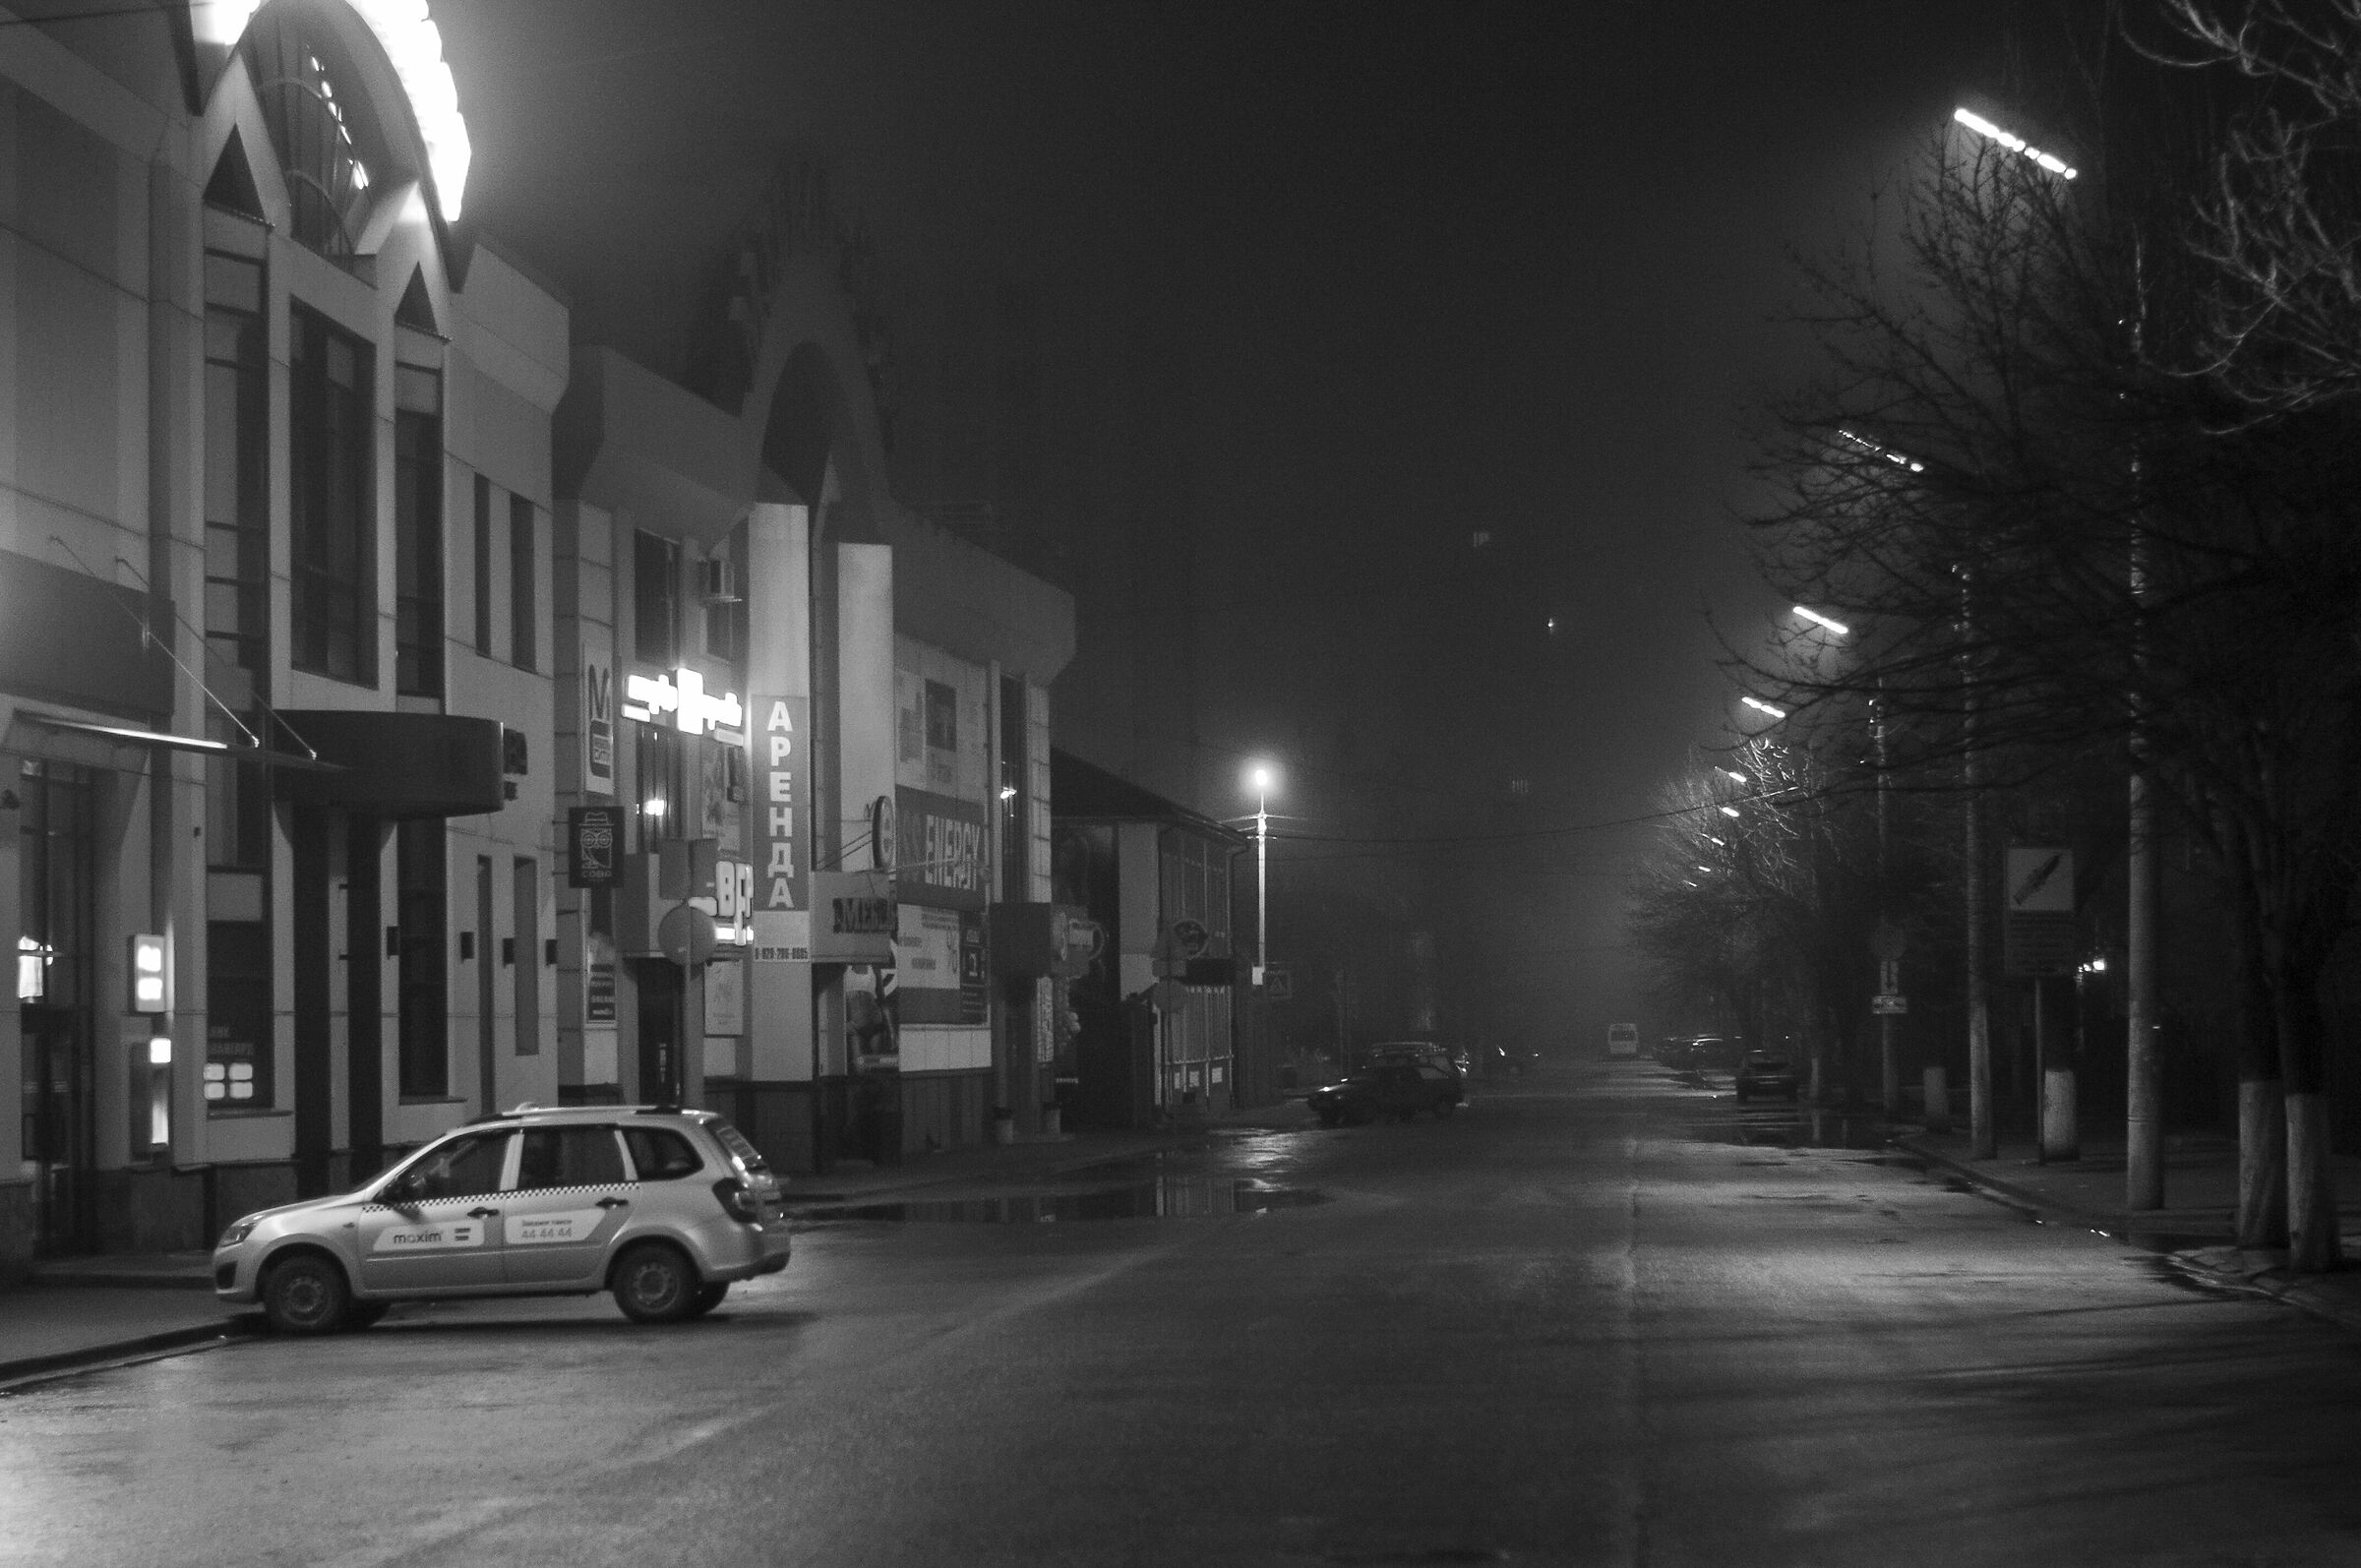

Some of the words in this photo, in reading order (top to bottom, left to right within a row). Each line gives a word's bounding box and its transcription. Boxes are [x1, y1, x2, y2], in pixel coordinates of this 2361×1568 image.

[767, 700, 794, 908] АРЕНДА
[925, 814, 980, 890] ENERGY
[394, 1231, 443, 1244] maxim
